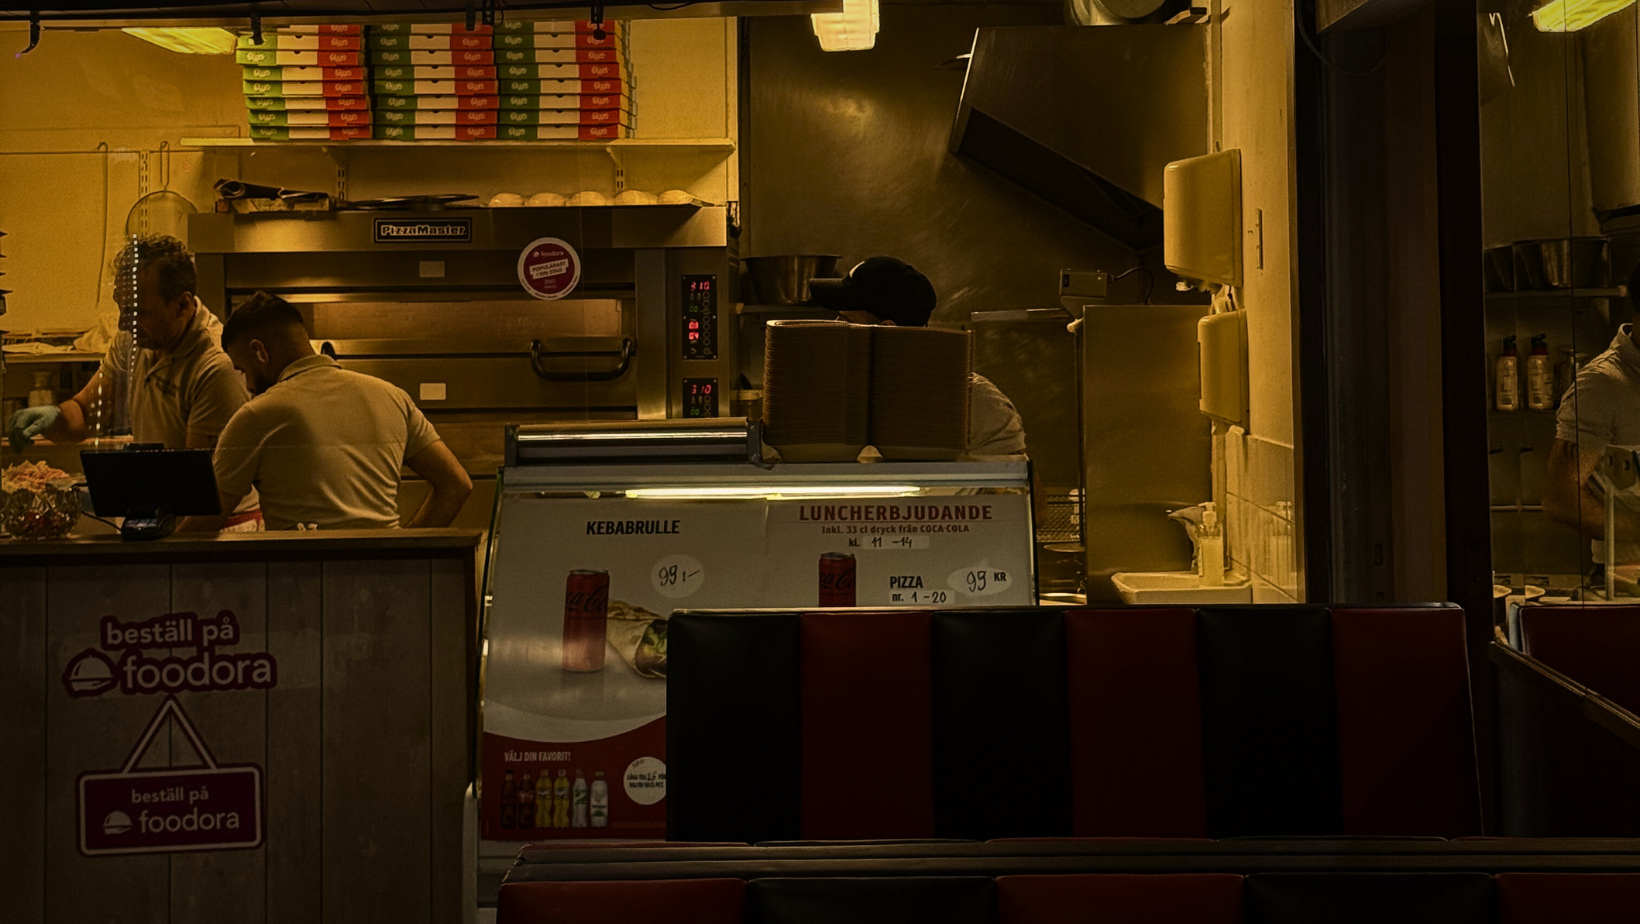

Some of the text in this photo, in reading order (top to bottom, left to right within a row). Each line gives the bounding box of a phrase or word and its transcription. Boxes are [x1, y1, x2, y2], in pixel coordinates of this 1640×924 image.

[380, 224, 466, 237] PizzaMaster
[799, 504, 993, 521] LUNCHERBJUDANDE
[586, 519, 681, 535] KEBABRULLE
[846, 525, 857, 534] 33
[870, 524, 896, 536] dryck
[898, 524, 918, 534] från
[889, 575, 924, 589] PIZZA
[993, 571, 1007, 582] KR
[106, 615, 235, 648] beställ på
[122, 651, 272, 689] foodora
[503, 749, 572, 762] VÄLJ DIN FAVORIT!
[131, 784, 210, 805] beställ på
[139, 806, 240, 834] foodora
